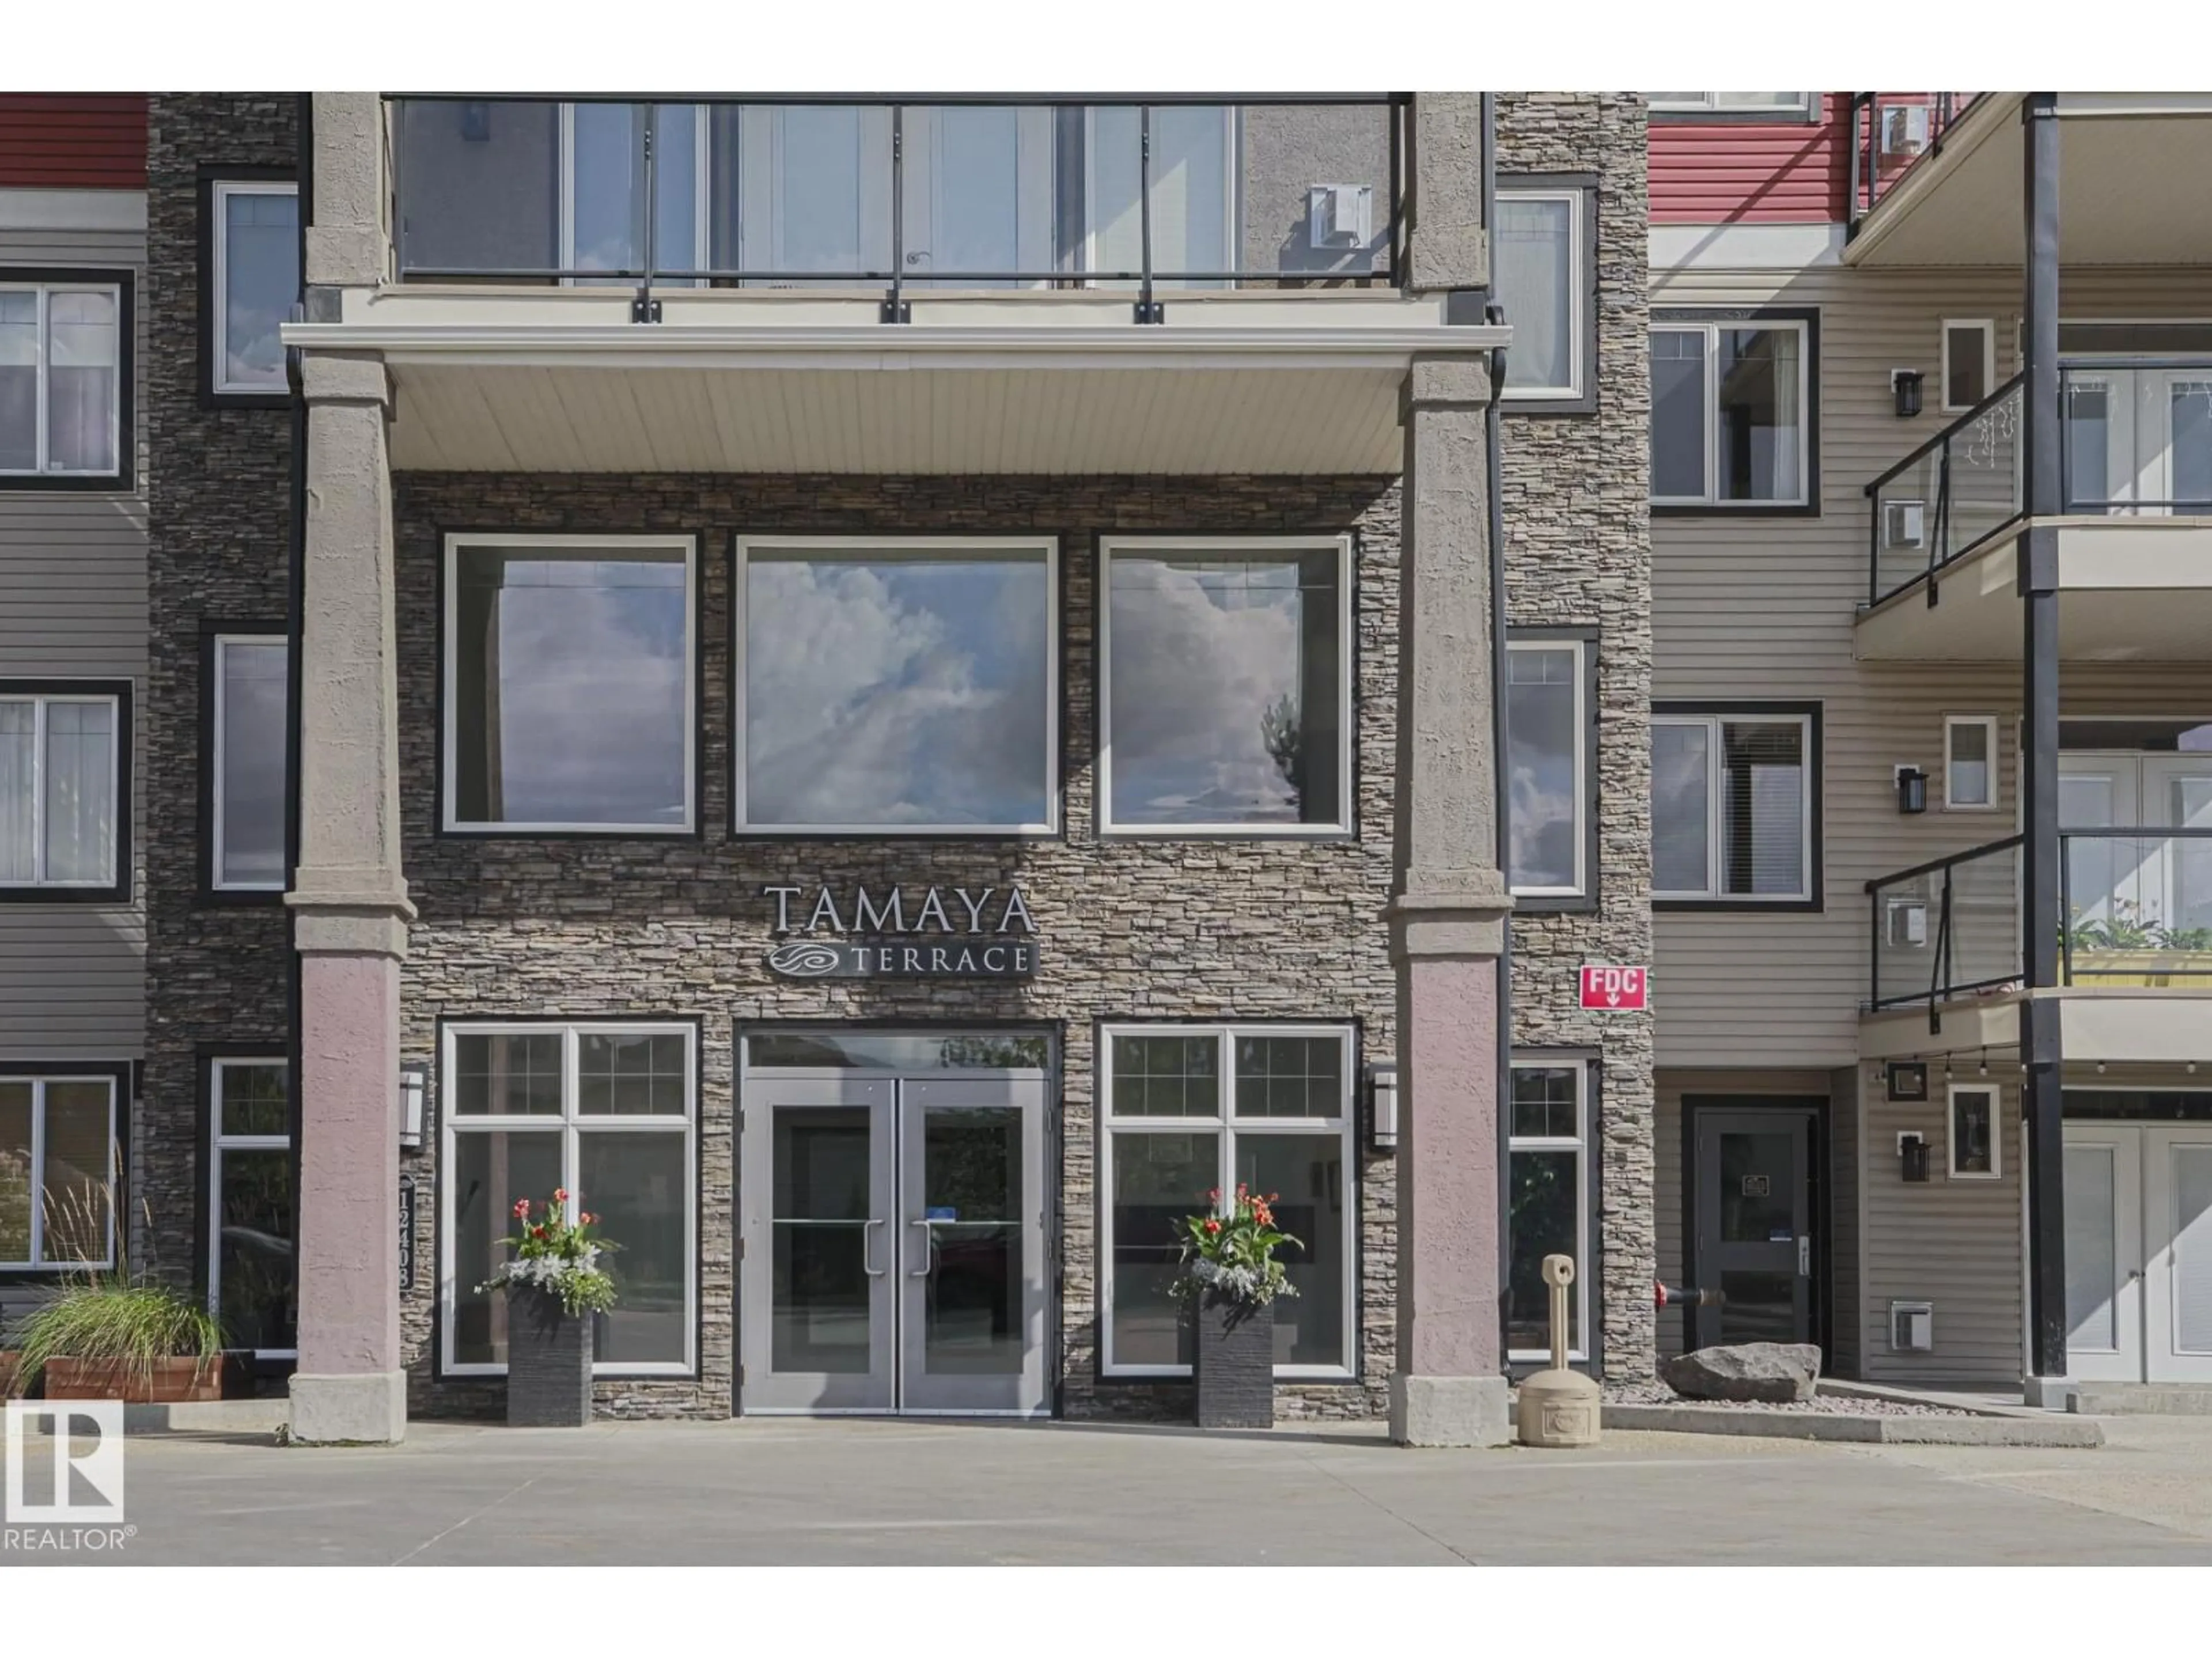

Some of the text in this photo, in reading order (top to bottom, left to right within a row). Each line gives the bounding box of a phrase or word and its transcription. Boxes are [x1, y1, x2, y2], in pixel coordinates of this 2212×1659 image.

[764, 885, 1039, 933] TAMAYA
[851, 947, 1028, 972] TERRACE
[1589, 968, 1638, 994] FDC
[399, 1191, 410, 1287] 12408
